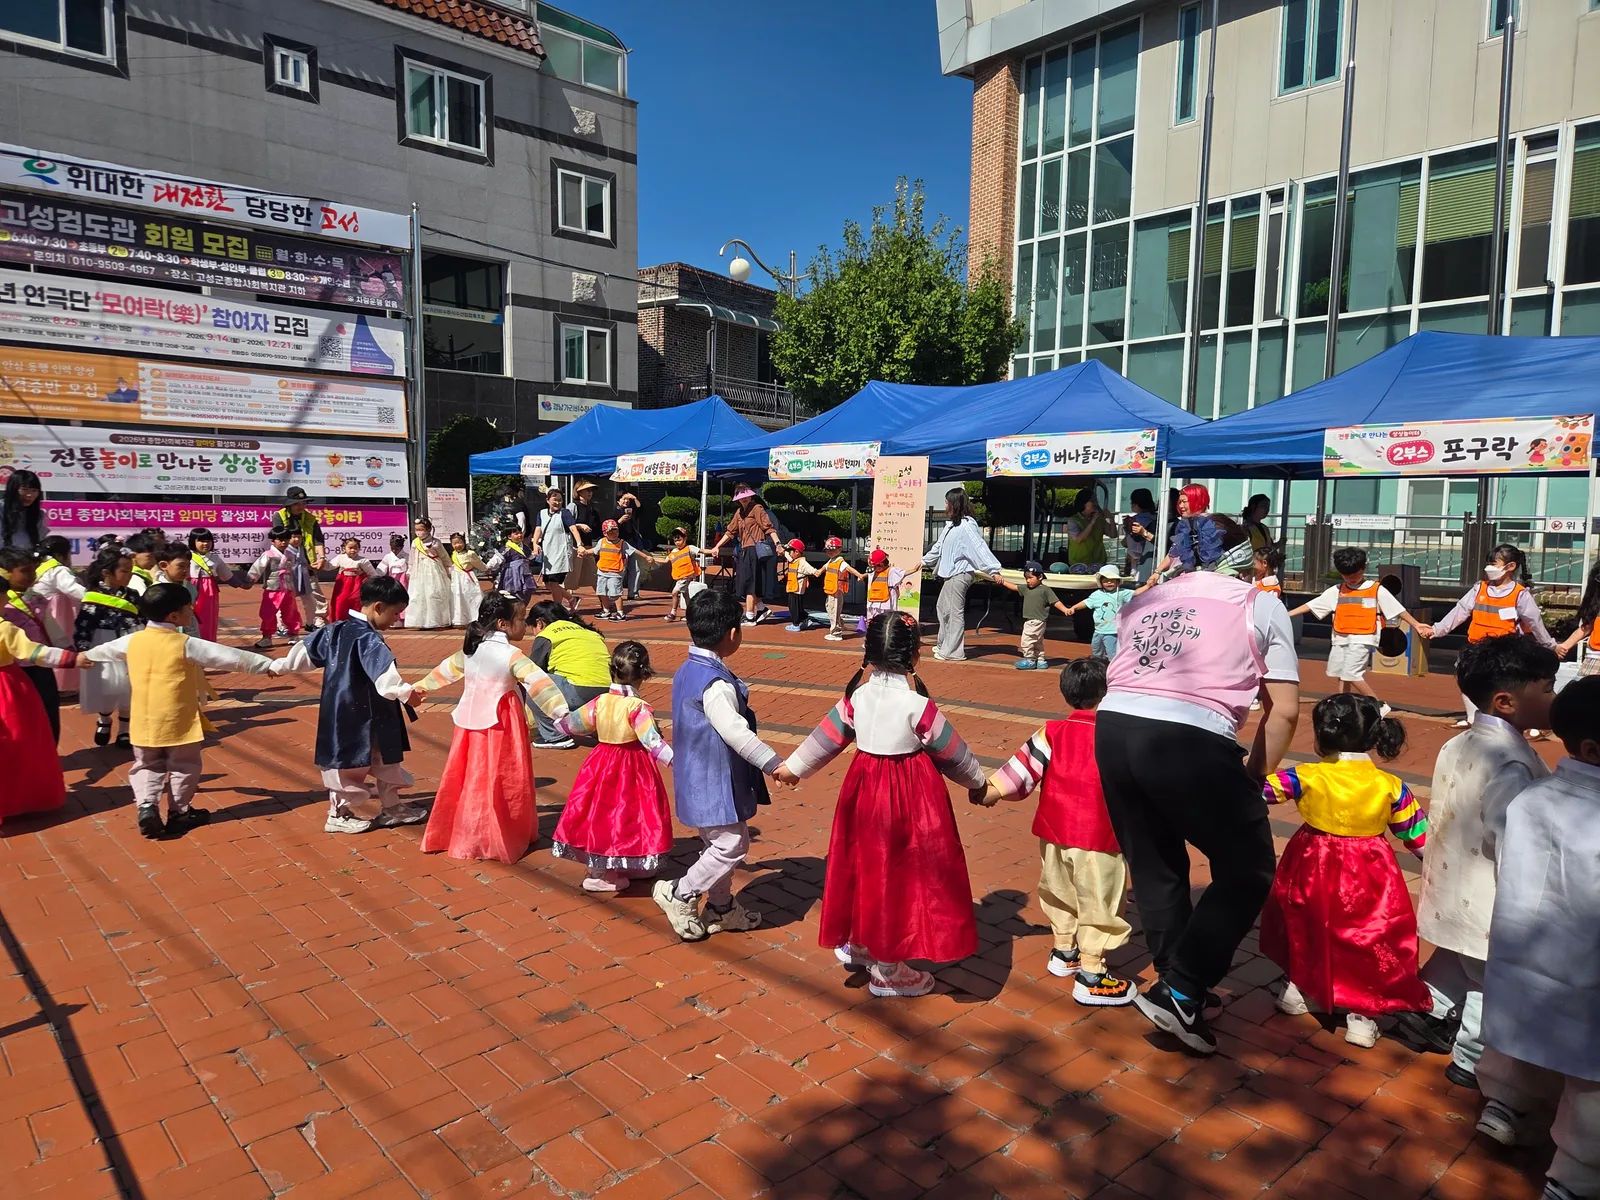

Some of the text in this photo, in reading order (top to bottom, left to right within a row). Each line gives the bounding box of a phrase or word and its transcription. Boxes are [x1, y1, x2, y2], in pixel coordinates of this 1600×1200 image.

[67, 166, 359, 233] 위대한 대전환 당당한 고성
[0, 200, 138, 244] 고성검도관
[144, 222, 195, 252] 회원
[202, 231, 250, 260] 모집
[33, 250, 155, 275] 문의처 010-9509-4967
[170, 269, 306, 296] 장소 고성군종합사회복지관 지하
[23, 284, 91, 313] 연극단
[211, 307, 270, 333] 참여자
[274, 315, 309, 338] 모집
[65, 382, 98, 398] 모집
[119, 435, 146, 444] 2026년
[147, 437, 194, 447] 종합사회복지관
[237, 441, 250, 449] 사업
[1368, 431, 1388, 439] 만나는
[1391, 430, 1421, 438] 상상놀이터
[1023, 445, 1116, 465] 3부스 버나돌리기
[1392, 436, 1519, 463] 2부스 포구락
[50, 447, 311, 476] 전통놀이로 만나는 상상놀이터
[644, 461, 679, 475] 대형윷놀이
[804, 458, 828, 471] 딱지치기
[833, 457, 861, 470] 신발던지기
[898, 465, 912, 478] 고성
[76, 508, 175, 522] 종합사회복지관
[178, 510, 217, 523] 앞마당
[221, 510, 258, 523] 활성화
[1565, 521, 1576, 531] 위
[1141, 606, 1197, 625] 아이들은
[1166, 621, 1201, 640] 위해
[1132, 636, 1182, 657] 세상에
